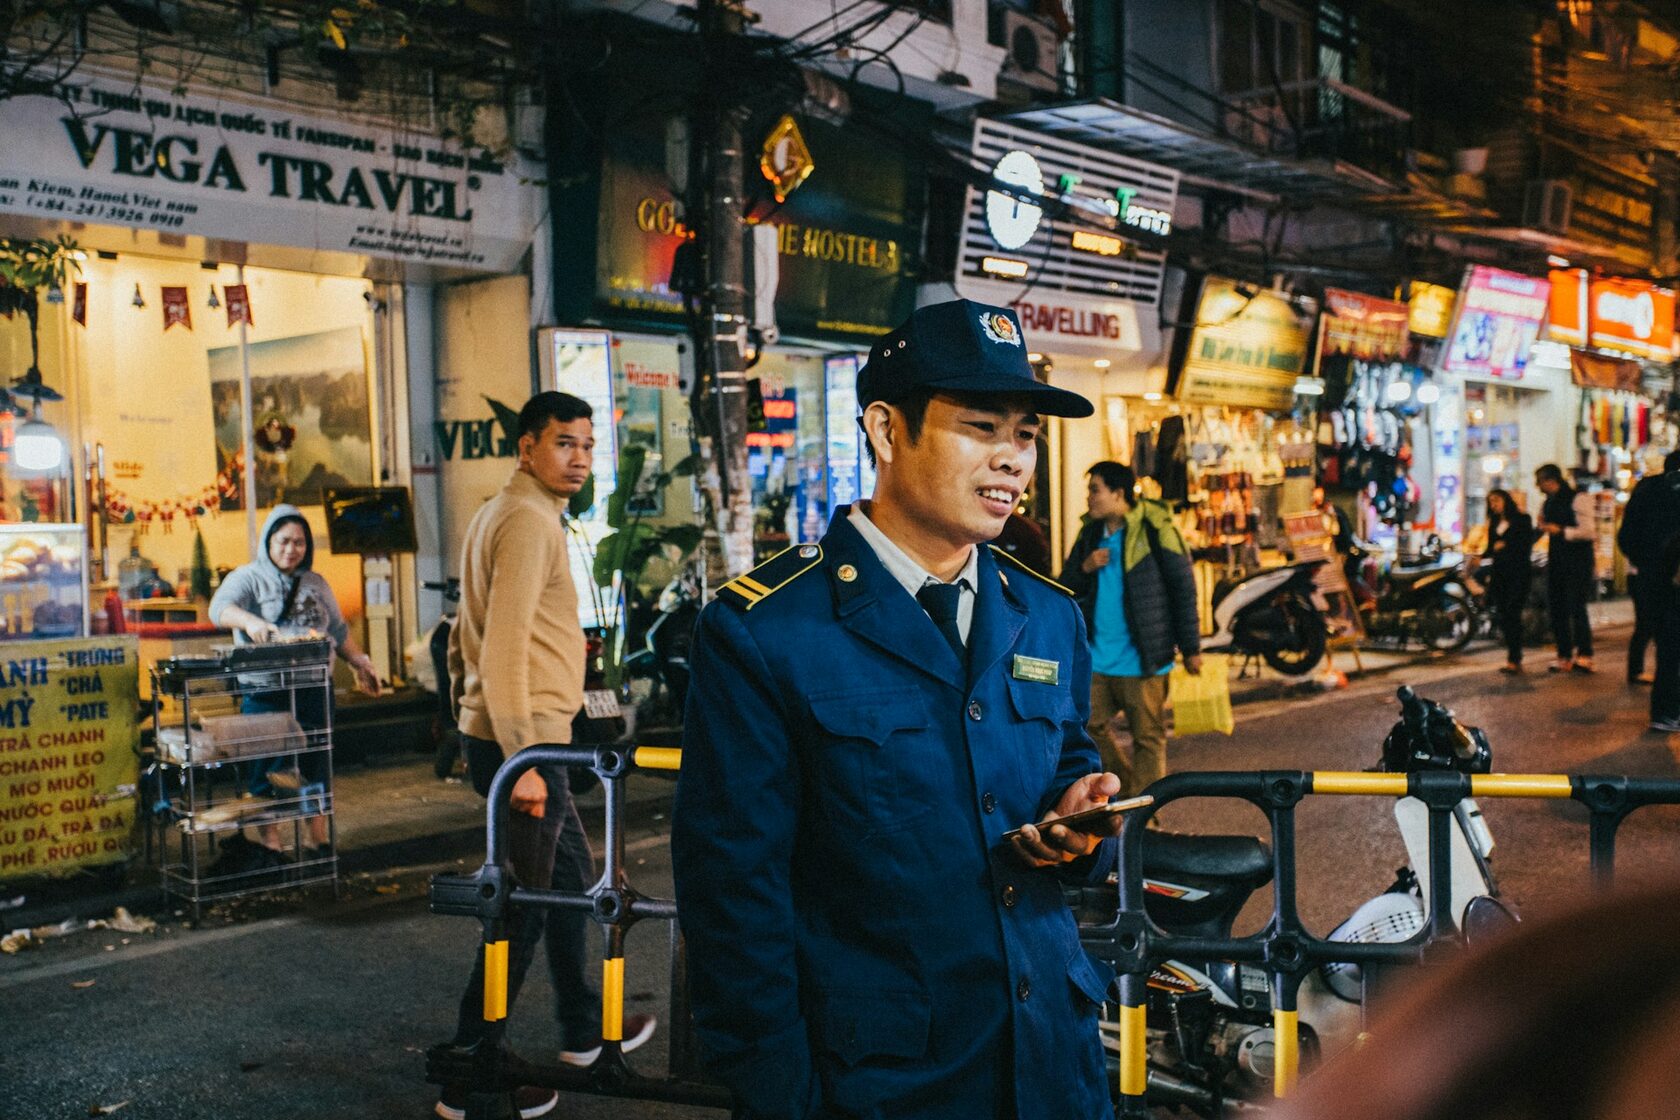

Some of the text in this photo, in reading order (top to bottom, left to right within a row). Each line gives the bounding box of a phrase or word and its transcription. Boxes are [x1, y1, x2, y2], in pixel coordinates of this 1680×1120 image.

[60, 116, 247, 193] VEGA
[257, 150, 473, 222] TRAVEL
[803, 226, 883, 267] HOSTEL
[1011, 300, 1121, 339] TRAVELLING
[37, 729, 105, 749] CHANH
[0, 751, 105, 777] CHANH LEO
[1149, 969, 1190, 987] ream
